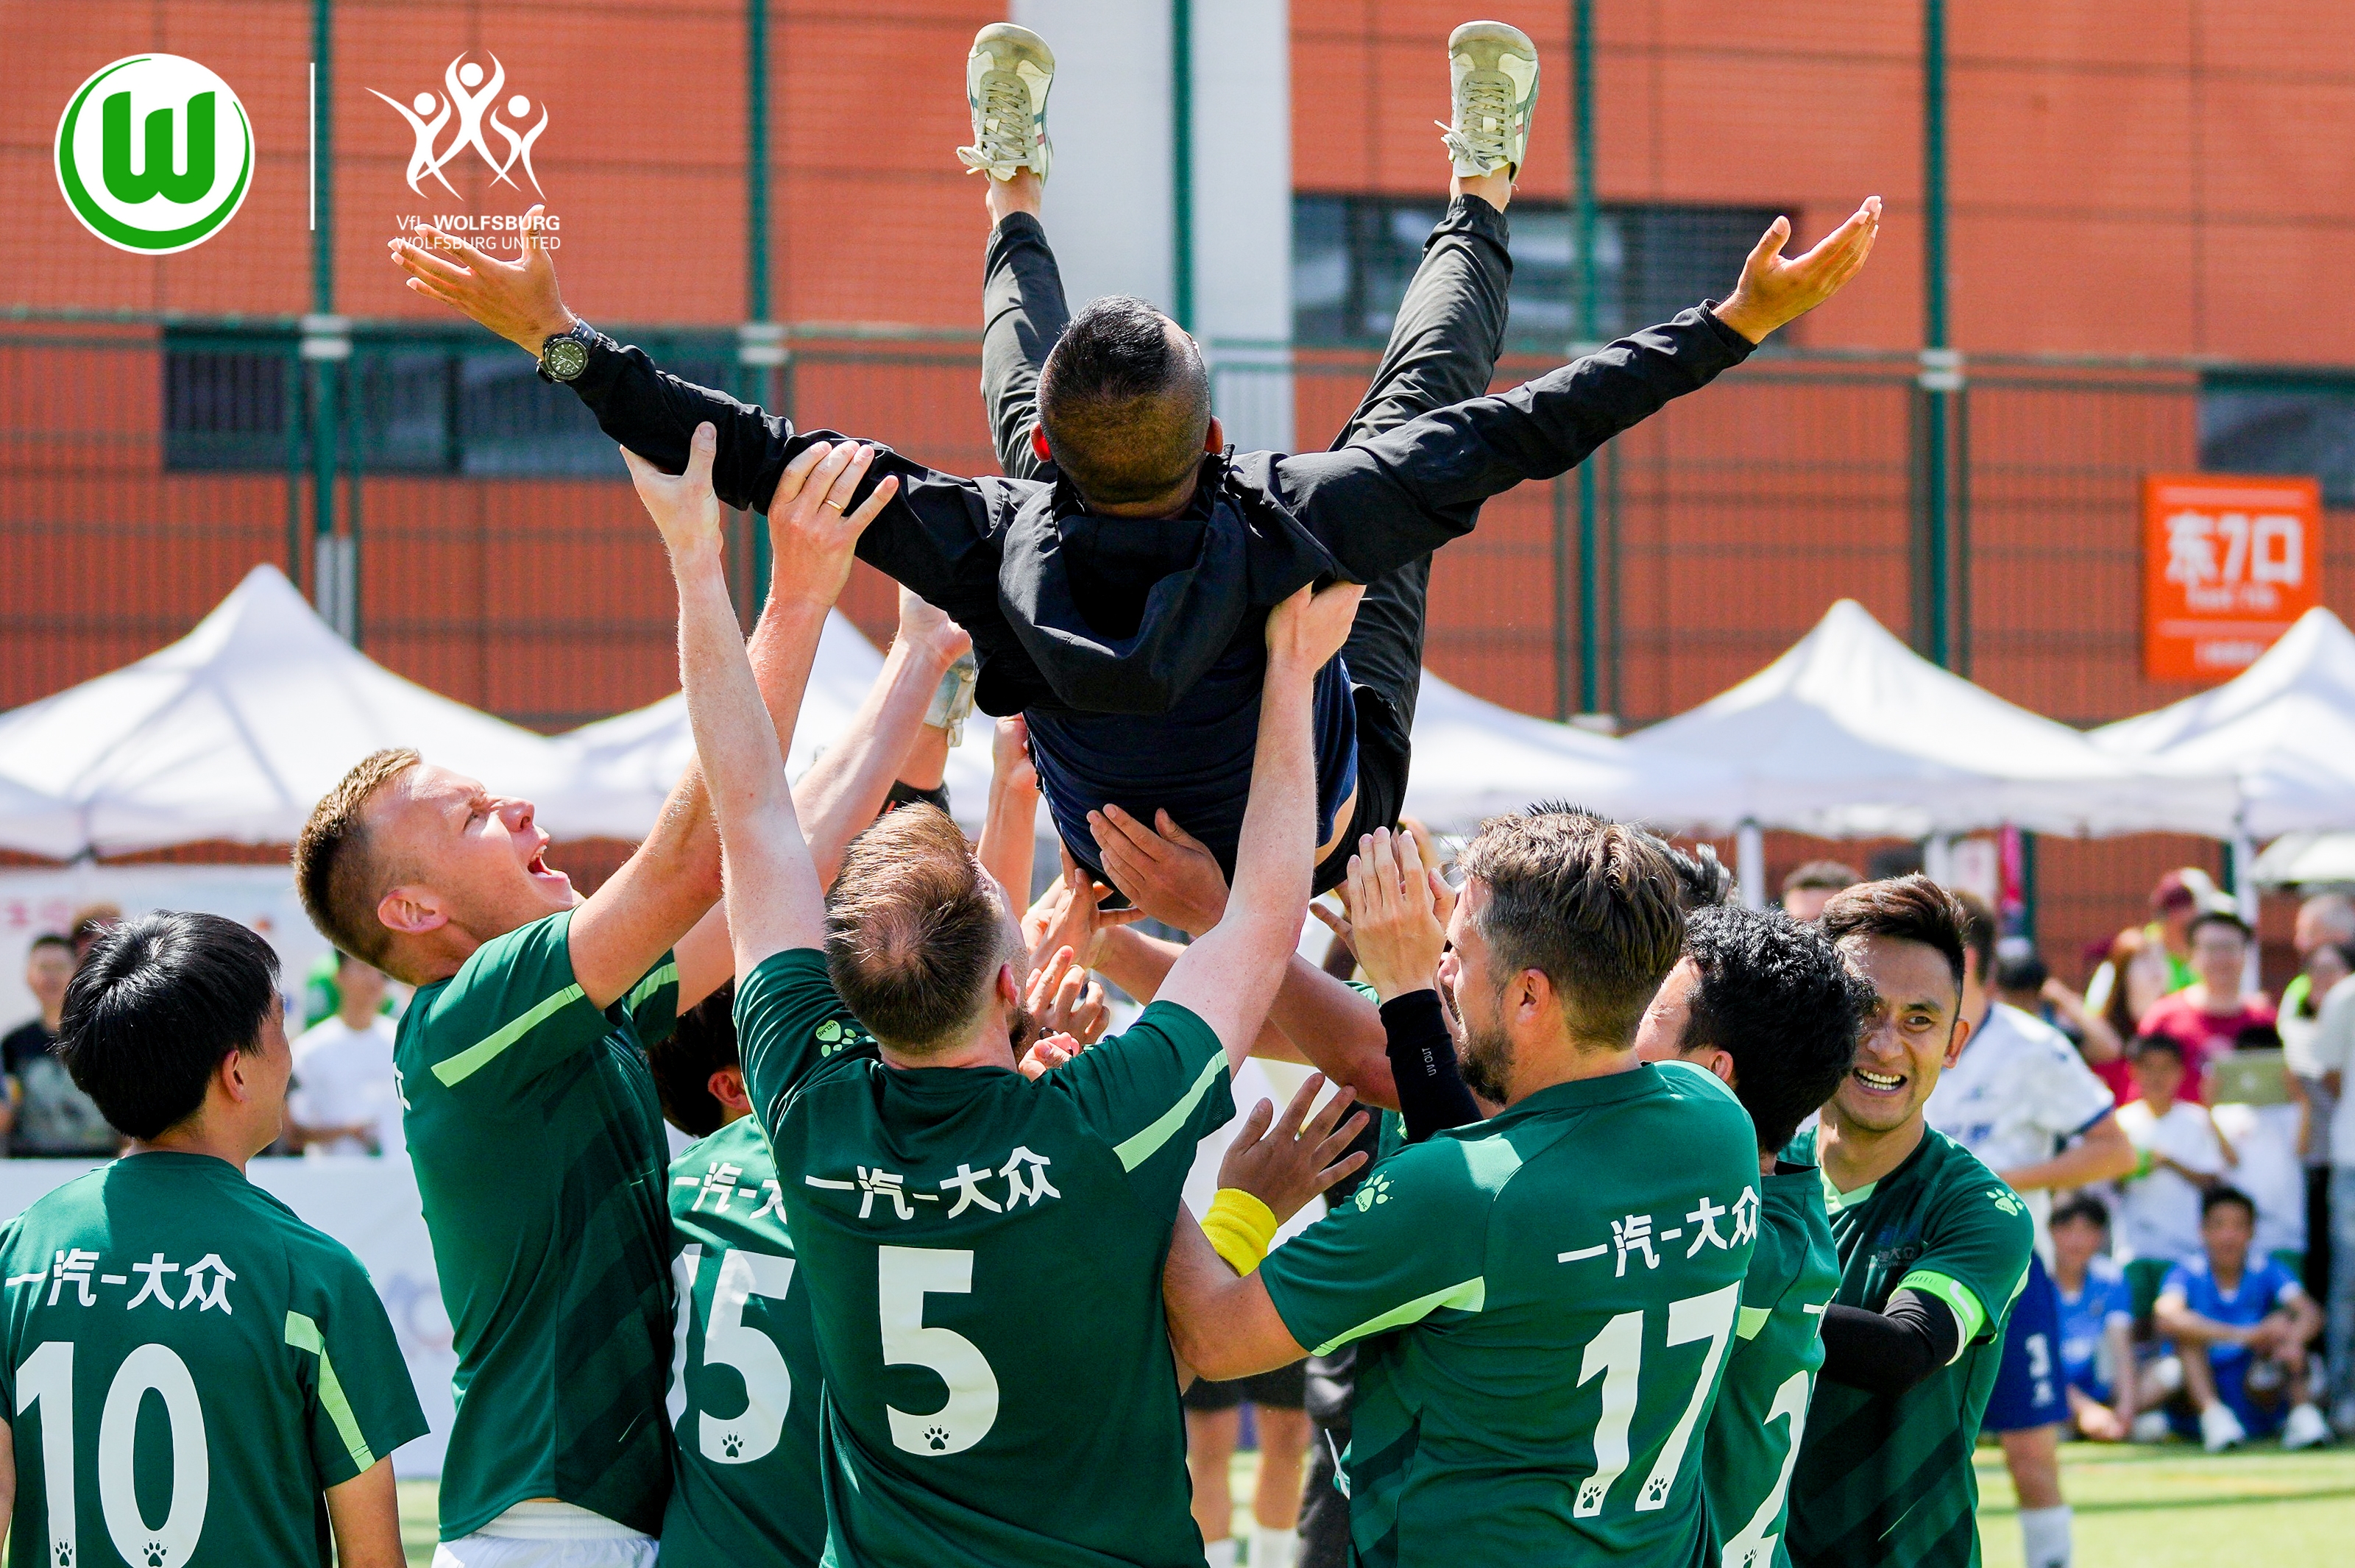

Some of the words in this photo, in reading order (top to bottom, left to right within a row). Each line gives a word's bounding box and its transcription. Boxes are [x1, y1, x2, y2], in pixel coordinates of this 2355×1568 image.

[816, 1021, 837, 1038] KELME
[1421, 1047, 1434, 1063] OUT
[1426, 1064, 1437, 1076] UV
[804, 1145, 1061, 1221] 一汽-大众
[1557, 1185, 1760, 1278] 一汽-大众
[4, 1248, 236, 1315] 一汽-大众
[878, 1245, 999, 1457] 5
[1573, 1280, 1742, 1519] 17
[15, 1341, 210, 1568] 10
